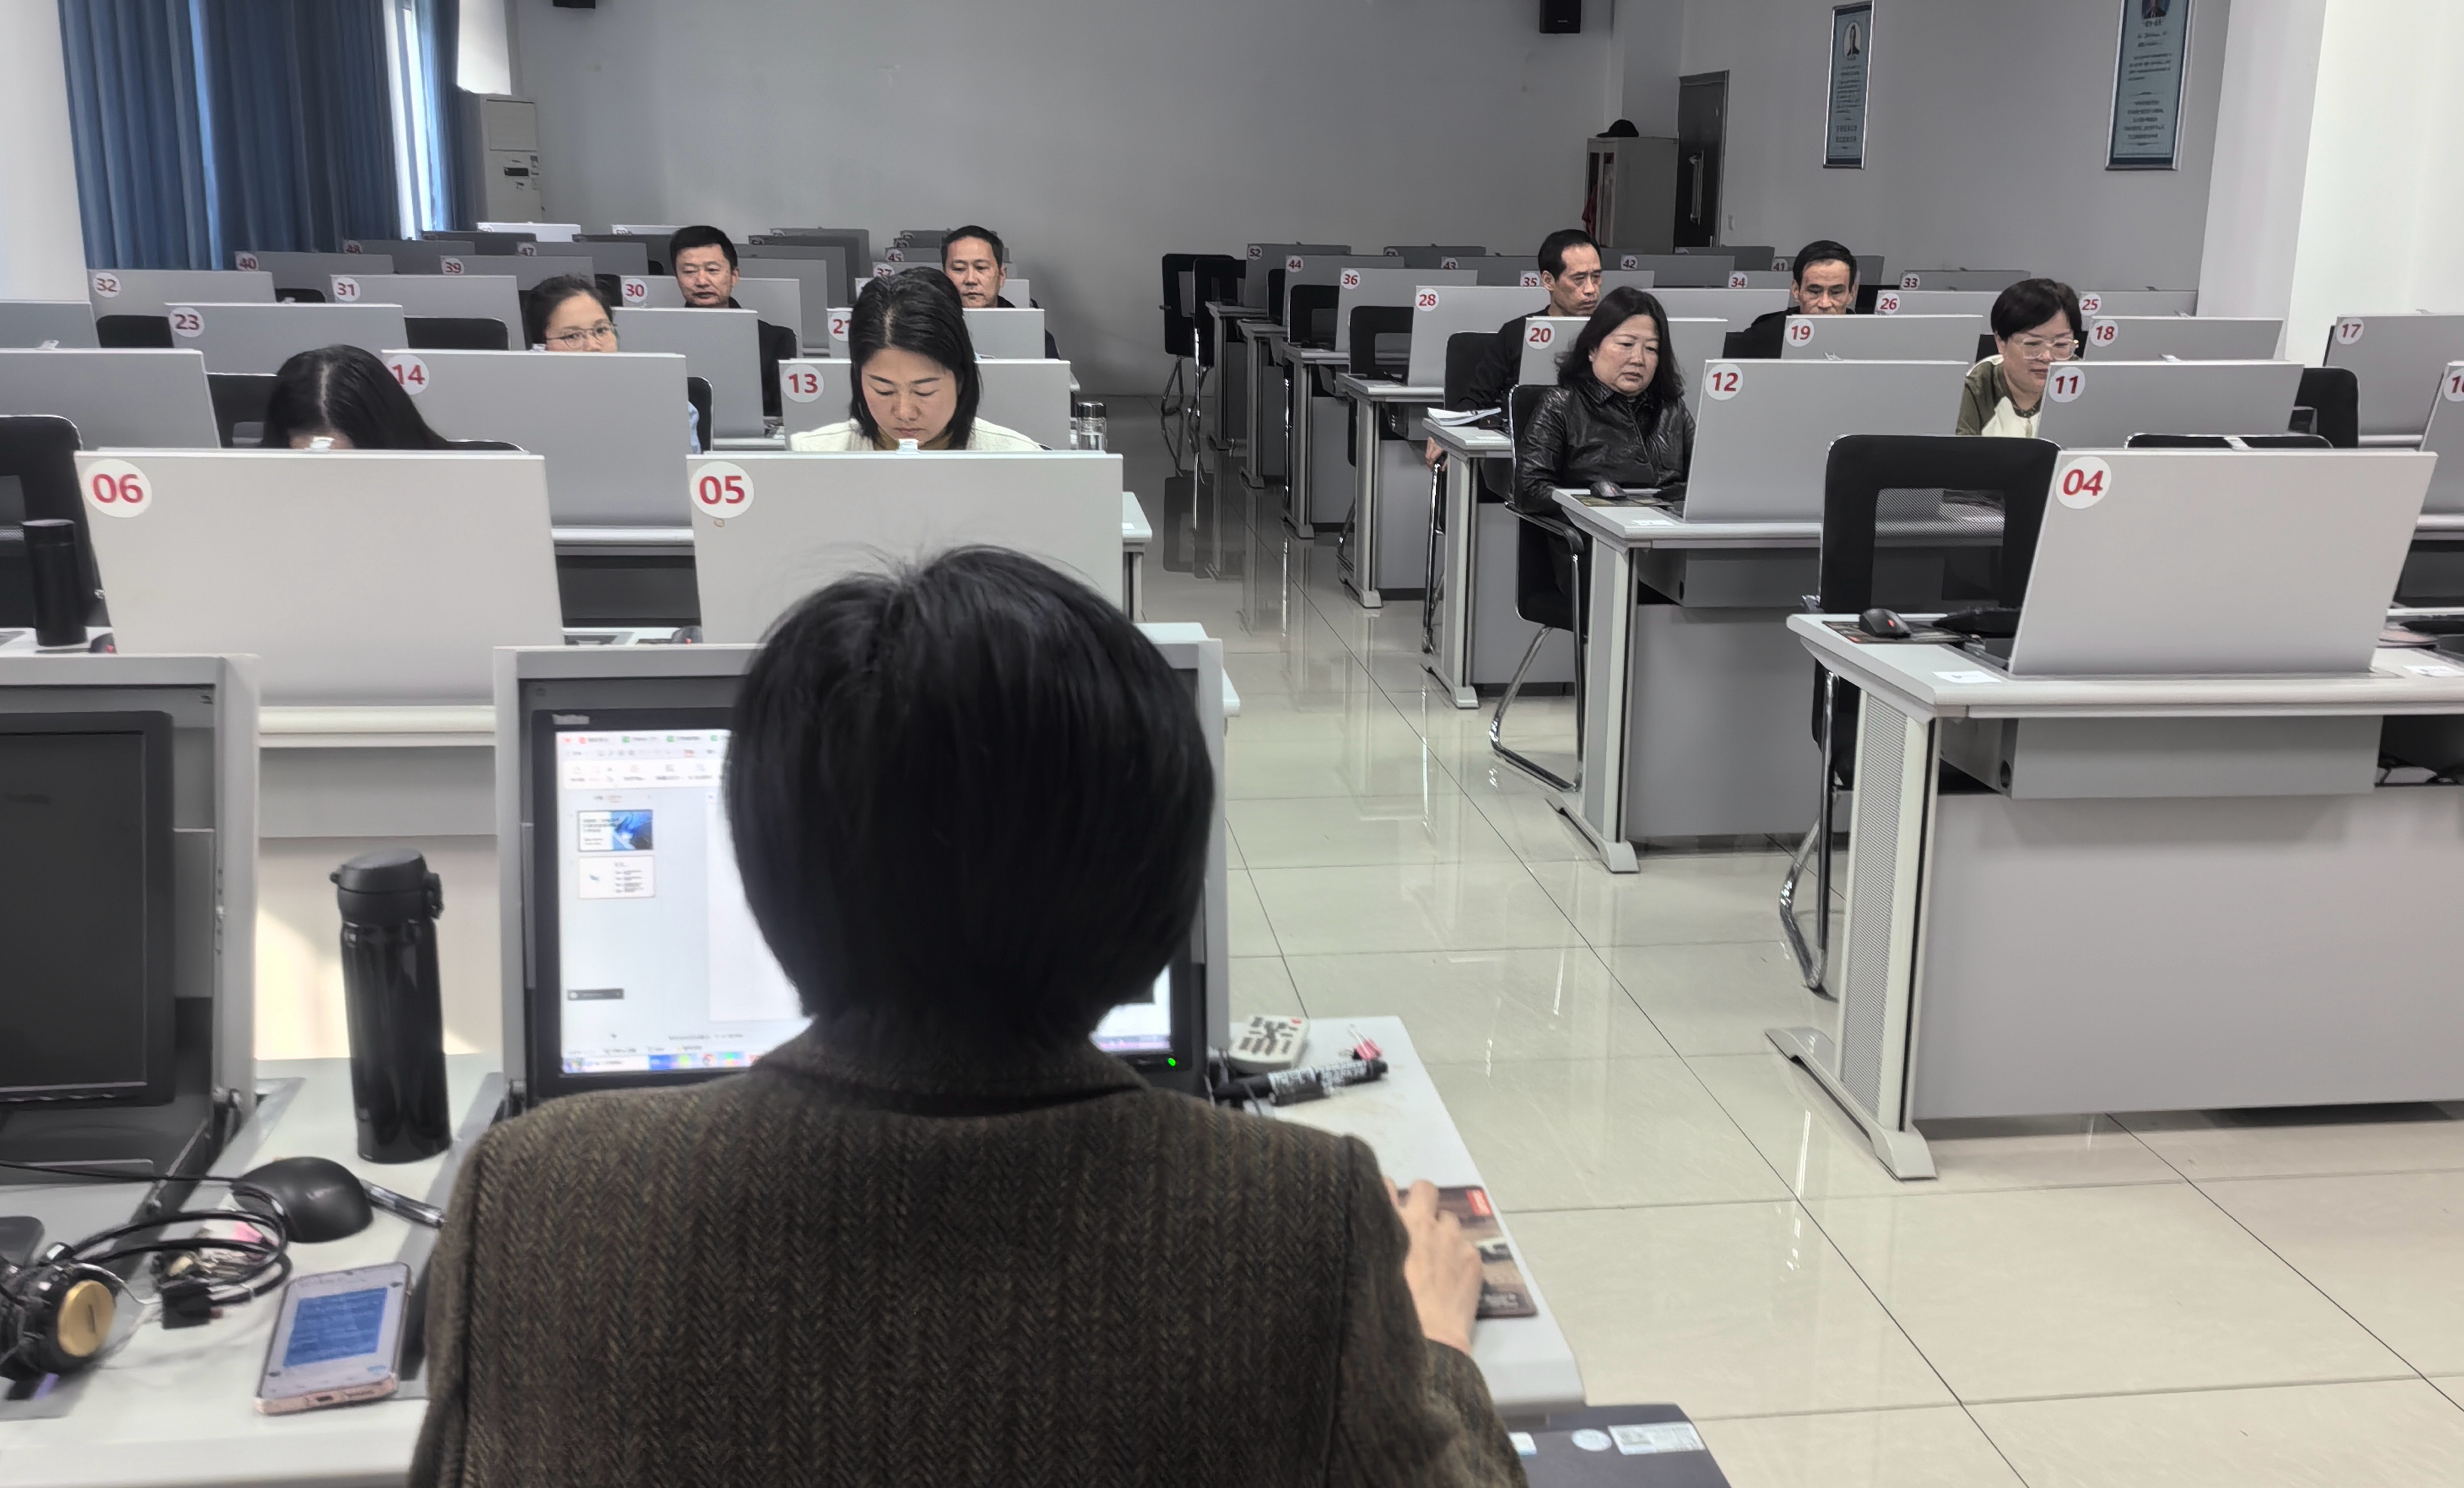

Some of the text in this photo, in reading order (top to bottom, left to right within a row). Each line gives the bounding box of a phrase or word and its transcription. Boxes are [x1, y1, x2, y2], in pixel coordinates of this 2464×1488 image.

[1249, 248, 1261, 257] 52
[445, 263, 462, 273] 39
[1289, 260, 1302, 269] 44
[1623, 259, 1637, 268] 42
[1773, 263, 1787, 271] 41
[97, 278, 119, 293] 32
[1343, 274, 1358, 285] 36
[1523, 276, 1538, 287] 35
[1731, 277, 1746, 288] 34
[1903, 277, 1919, 288] 33
[337, 283, 356, 297] 31
[626, 284, 645, 297] 30
[1418, 294, 1437, 307] 28
[1880, 298, 1898, 311] 26
[2082, 299, 2098, 310] 25
[175, 313, 201, 331] 23
[1529, 327, 1551, 343] 20
[1791, 325, 1811, 341] 19
[2096, 325, 2114, 340] 18
[2343, 324, 2362, 337] 17
[393, 365, 425, 385] 14
[789, 374, 818, 394] 13
[1713, 372, 1739, 392] 12
[2055, 376, 2079, 394] 11
[2452, 375, 2464, 394] 1
[92, 474, 144, 504] 06
[2062, 469, 2104, 497] 04
[699, 476, 744, 505] 05
